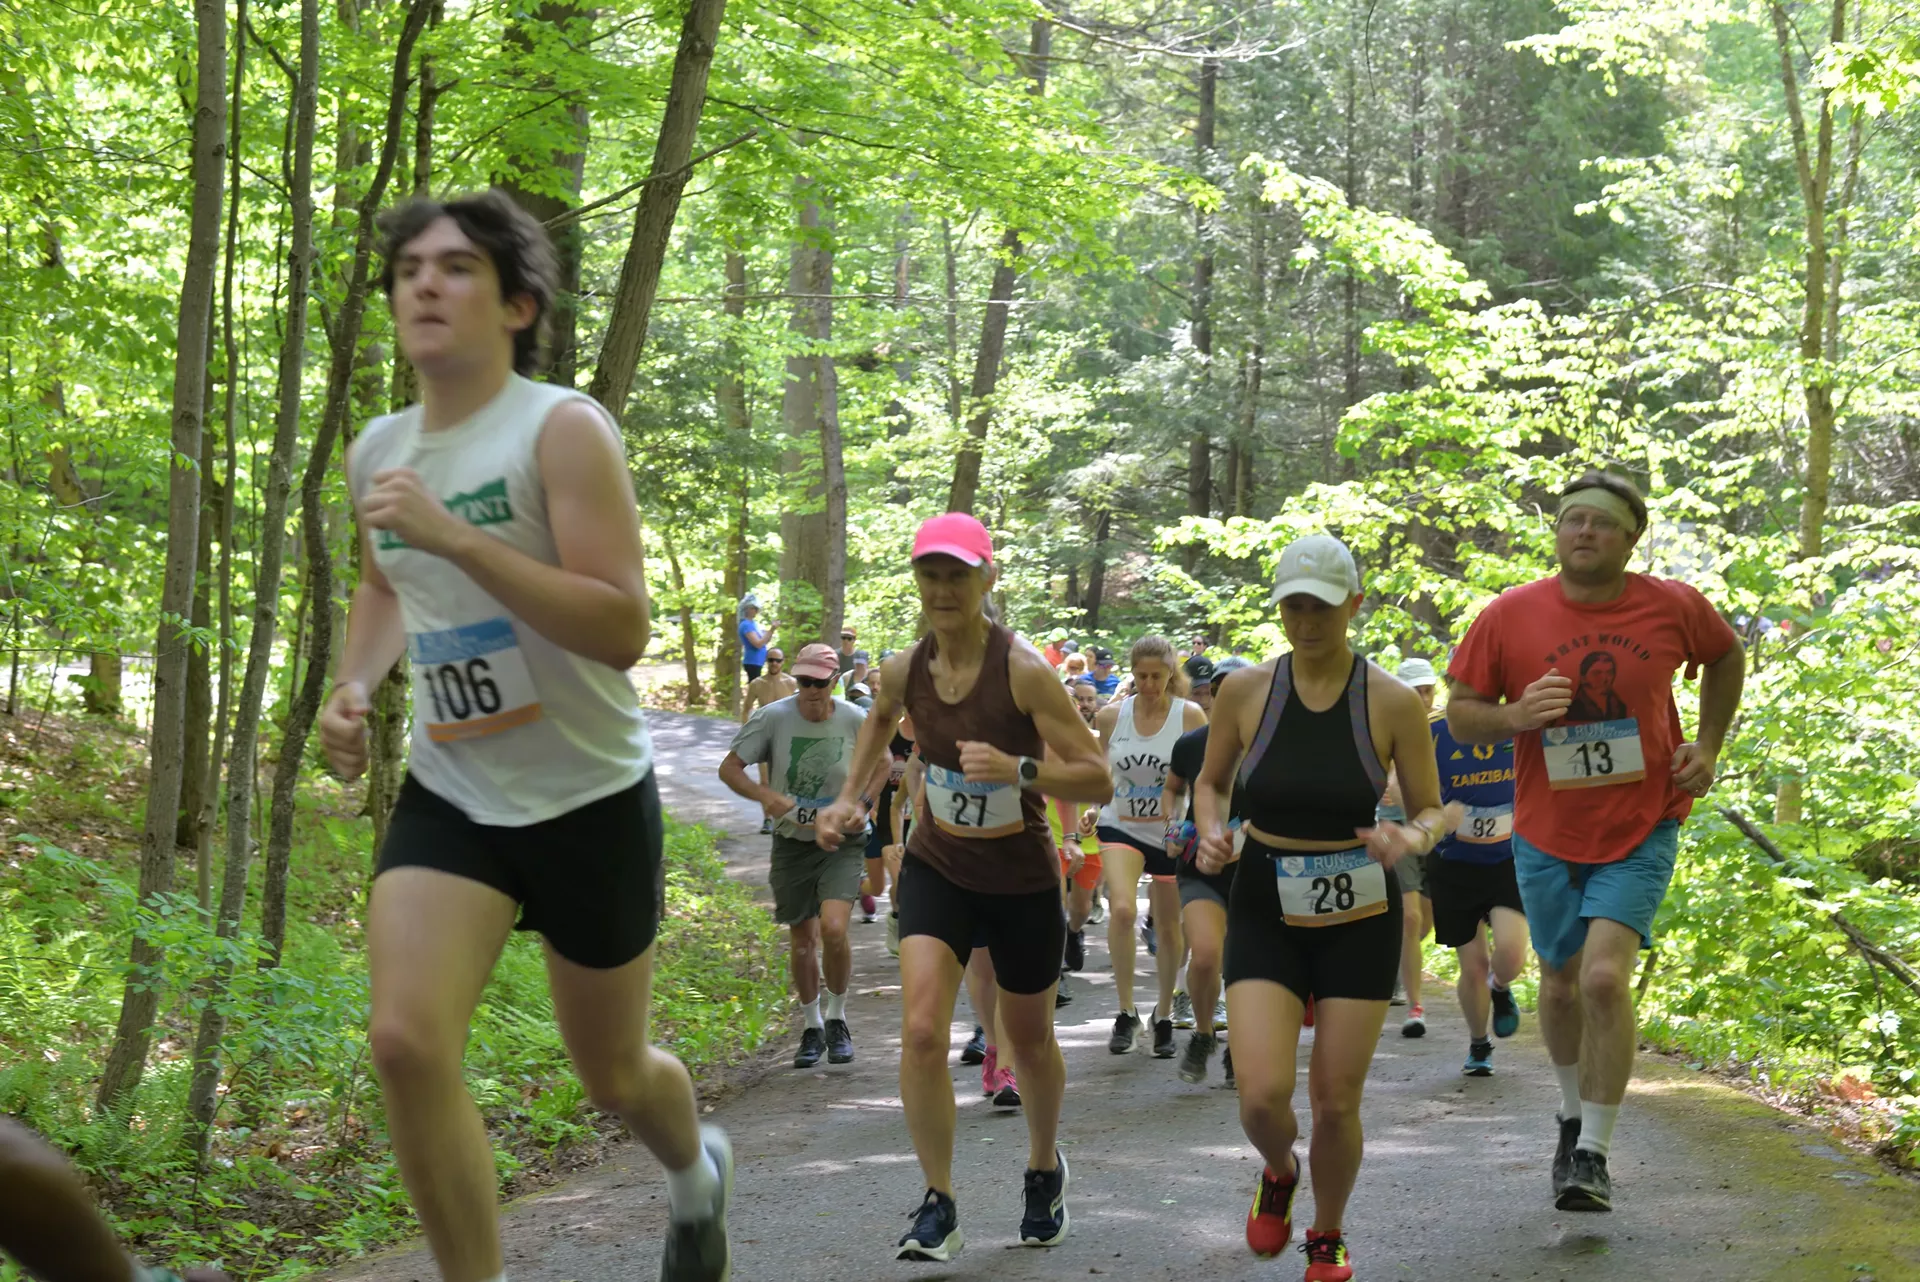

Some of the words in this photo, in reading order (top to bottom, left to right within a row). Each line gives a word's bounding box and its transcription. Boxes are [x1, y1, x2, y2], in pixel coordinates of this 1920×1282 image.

[1544, 635, 1589, 664] WHAT
[1598, 633, 1651, 660] WOULD
[423, 657, 503, 722] 106
[1576, 741, 1614, 777] 13
[797, 807, 817, 824] 64
[952, 792, 987, 827] 27
[1128, 797, 1160, 817] 122
[1472, 818, 1496, 837] 92
[1313, 852, 1346, 869] RUN
[1312, 873, 1355, 914] 28
